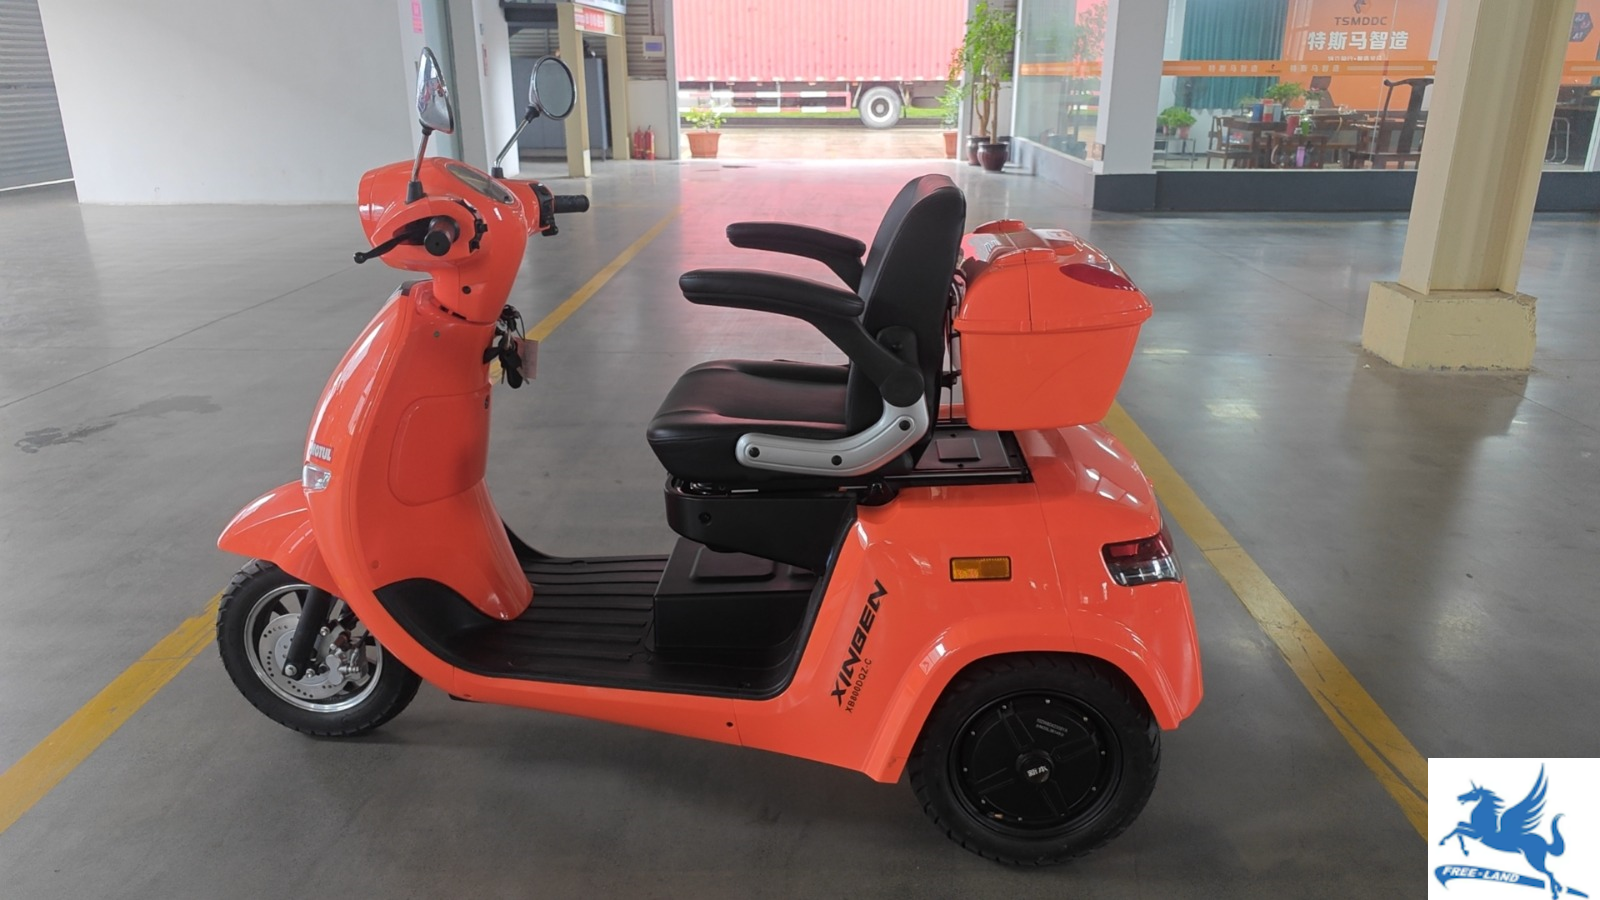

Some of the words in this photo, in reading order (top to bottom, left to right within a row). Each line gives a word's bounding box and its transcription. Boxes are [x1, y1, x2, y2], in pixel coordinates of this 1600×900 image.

[1334, 16, 1388, 26] TSMDDC
[1307, 30, 1409, 50] 特斯马智造
[831, 579, 888, 707] XINBEN
[845, 658, 872, 713] XB800DQZ-C
